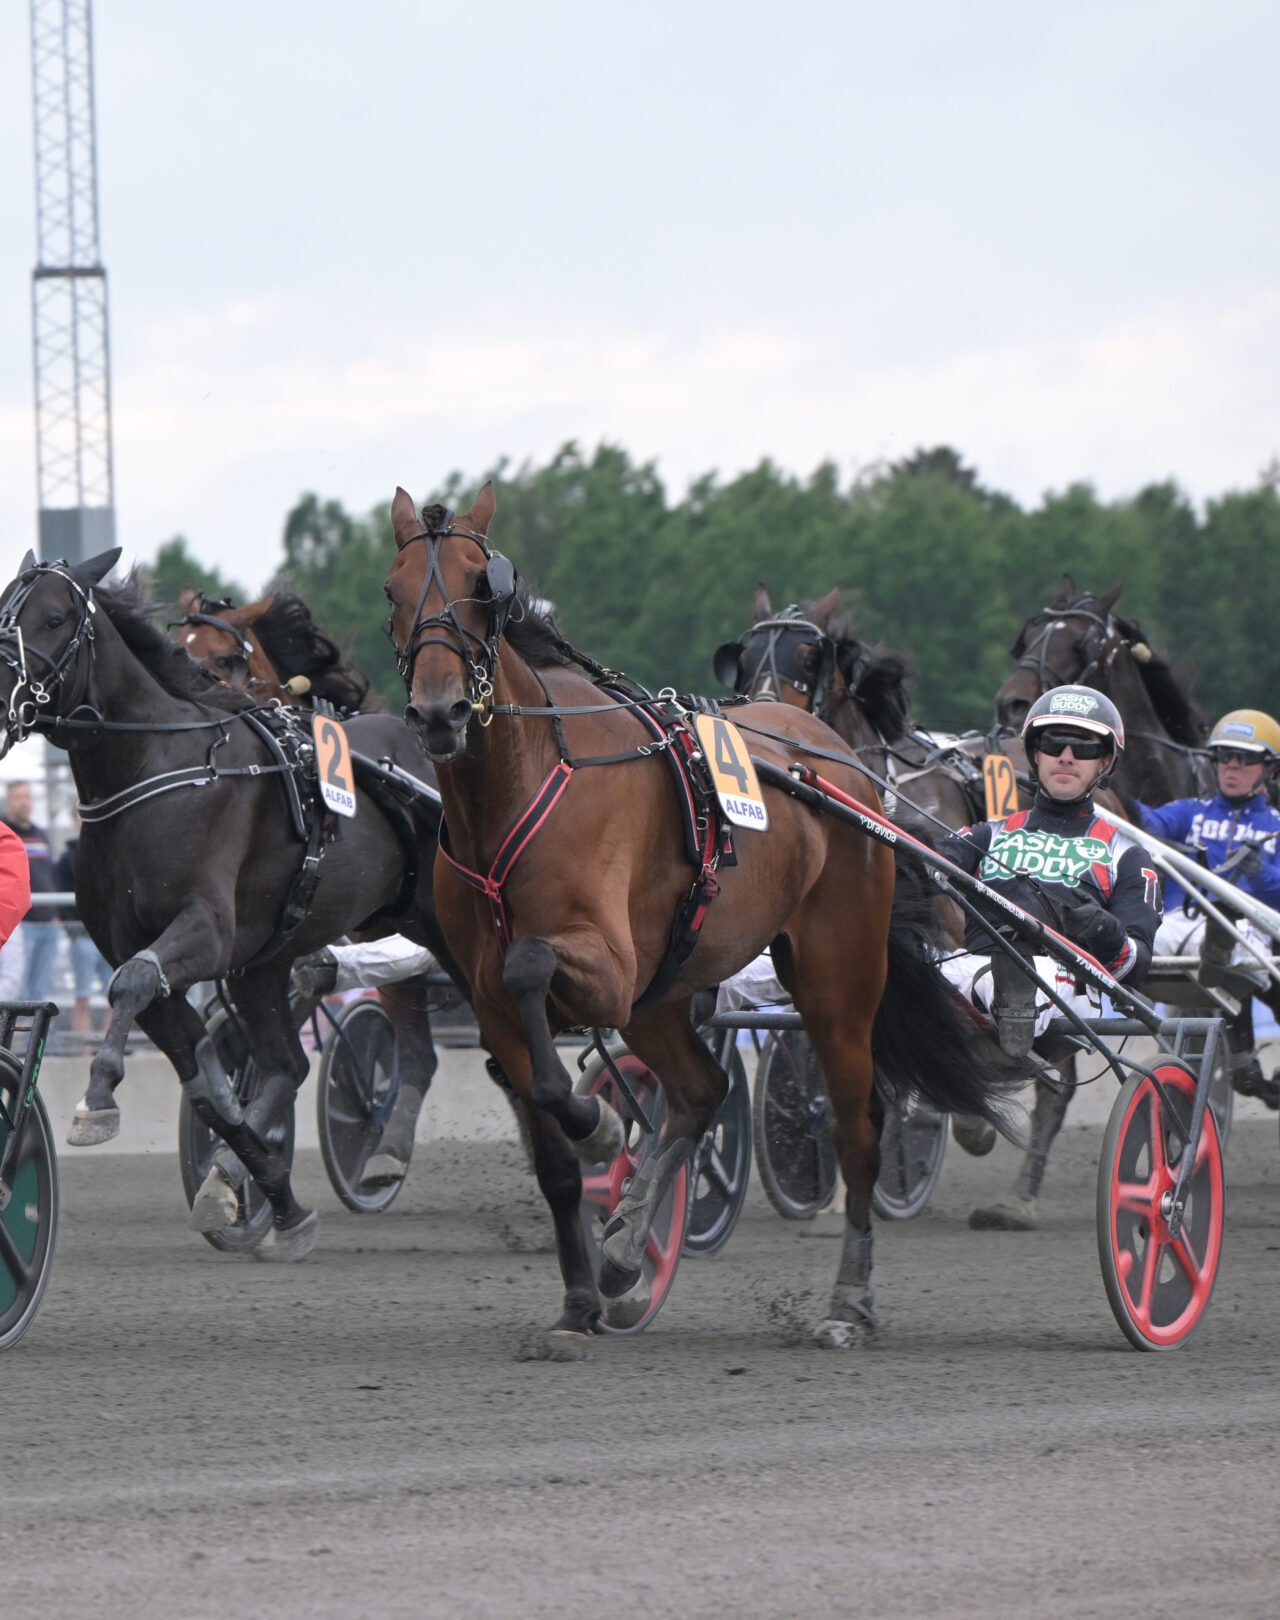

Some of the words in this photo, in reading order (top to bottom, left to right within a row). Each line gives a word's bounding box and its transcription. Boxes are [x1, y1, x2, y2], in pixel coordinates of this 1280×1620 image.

[1051, 700, 1091, 713] BUDDY
[1053, 694, 1083, 704] CASH
[322, 721, 348, 791] 2
[713, 719, 749, 795] 4
[325, 787, 353, 809] ALFAB
[987, 759, 1018, 816] 12
[726, 799, 765, 821] ALFAB
[989, 833, 1070, 857] CASH
[983, 850, 1086, 882] BUDDY
[1074, 953, 1116, 989] YANKEE
